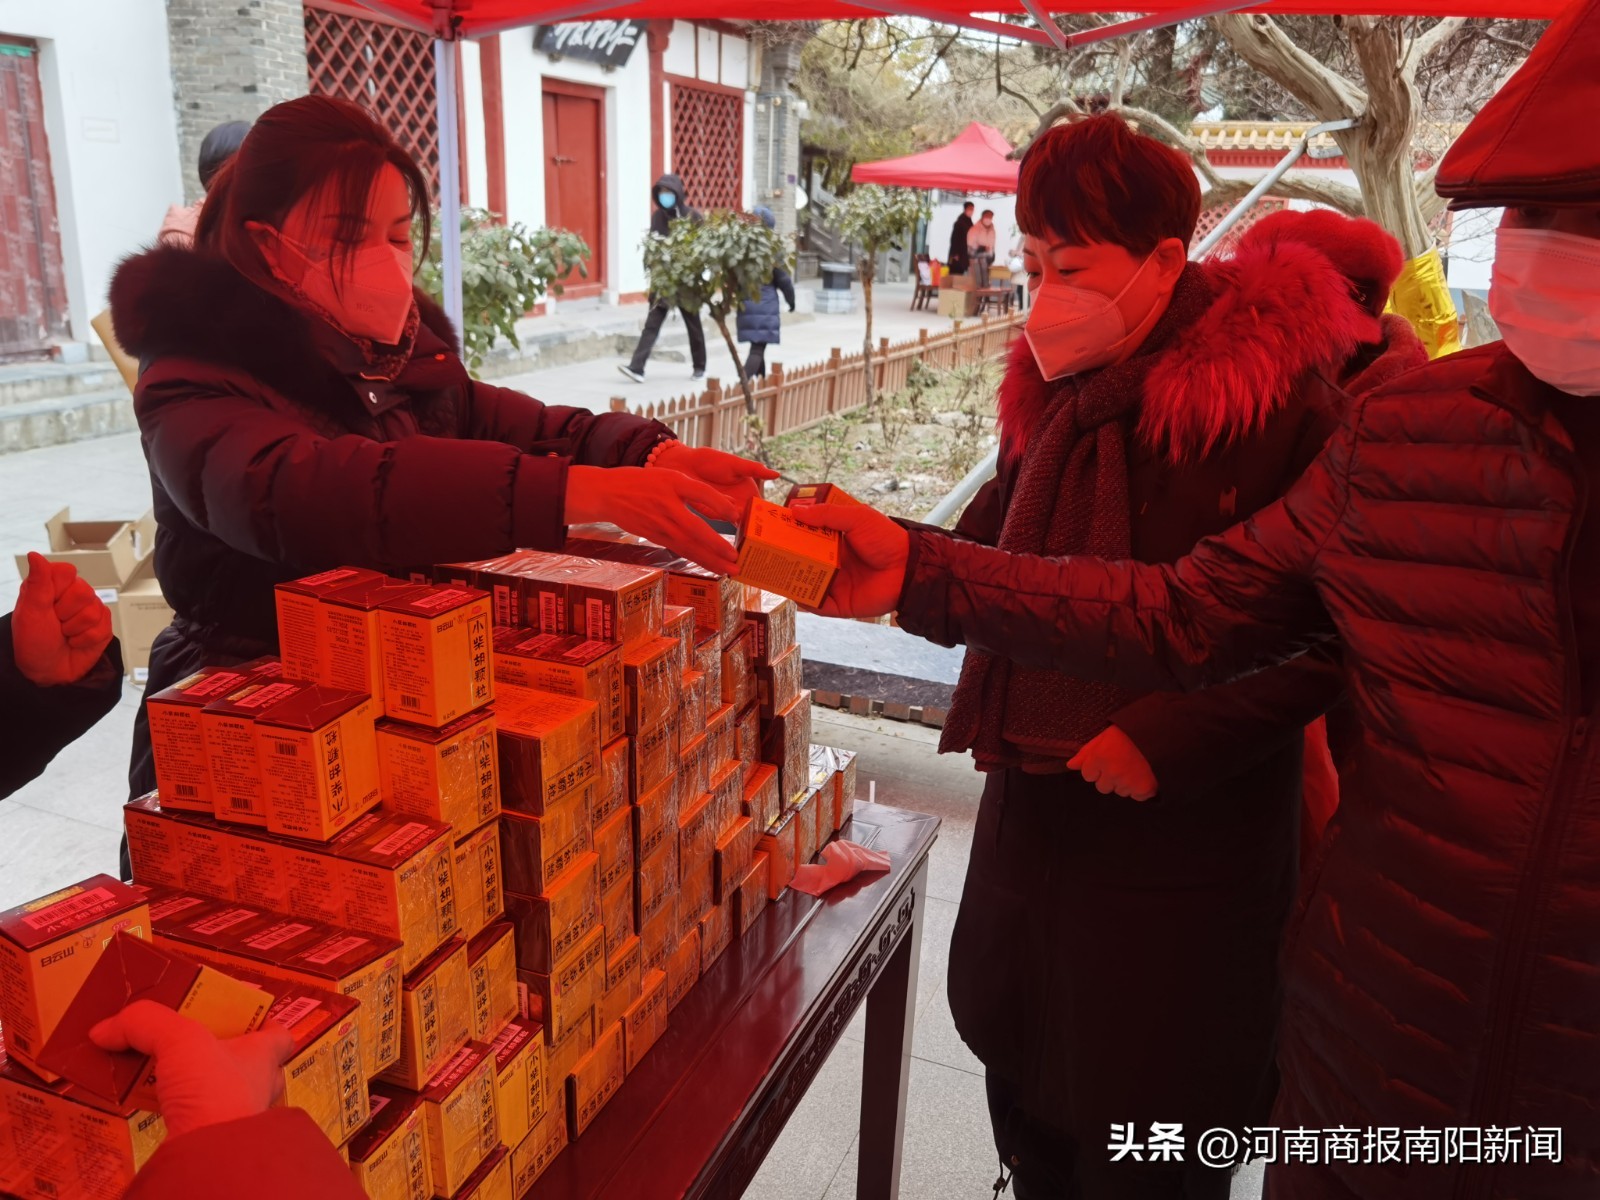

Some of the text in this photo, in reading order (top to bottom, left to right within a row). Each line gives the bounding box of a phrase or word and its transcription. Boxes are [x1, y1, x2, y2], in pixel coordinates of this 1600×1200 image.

[436, 620, 454, 634] 白云山
[472, 619, 487, 699] 小柴胡颗粒
[325, 729, 344, 813] 小柴胡颗粒
[480, 739, 494, 816] 小柴胡颗粒
[436, 855, 453, 934] 小柴胡颗粒
[483, 844, 497, 917] 小柴胡颗粒
[40, 945, 75, 968] 白云山
[378, 972, 396, 1063] 小柴胡颗粒
[291, 1055, 316, 1079] 白云山
[340, 1039, 361, 1130] 小柴胡颗粒
[529, 1054, 542, 1120] 小柴胡颗粒
[480, 1077, 494, 1150] 小柴胡颗粒
